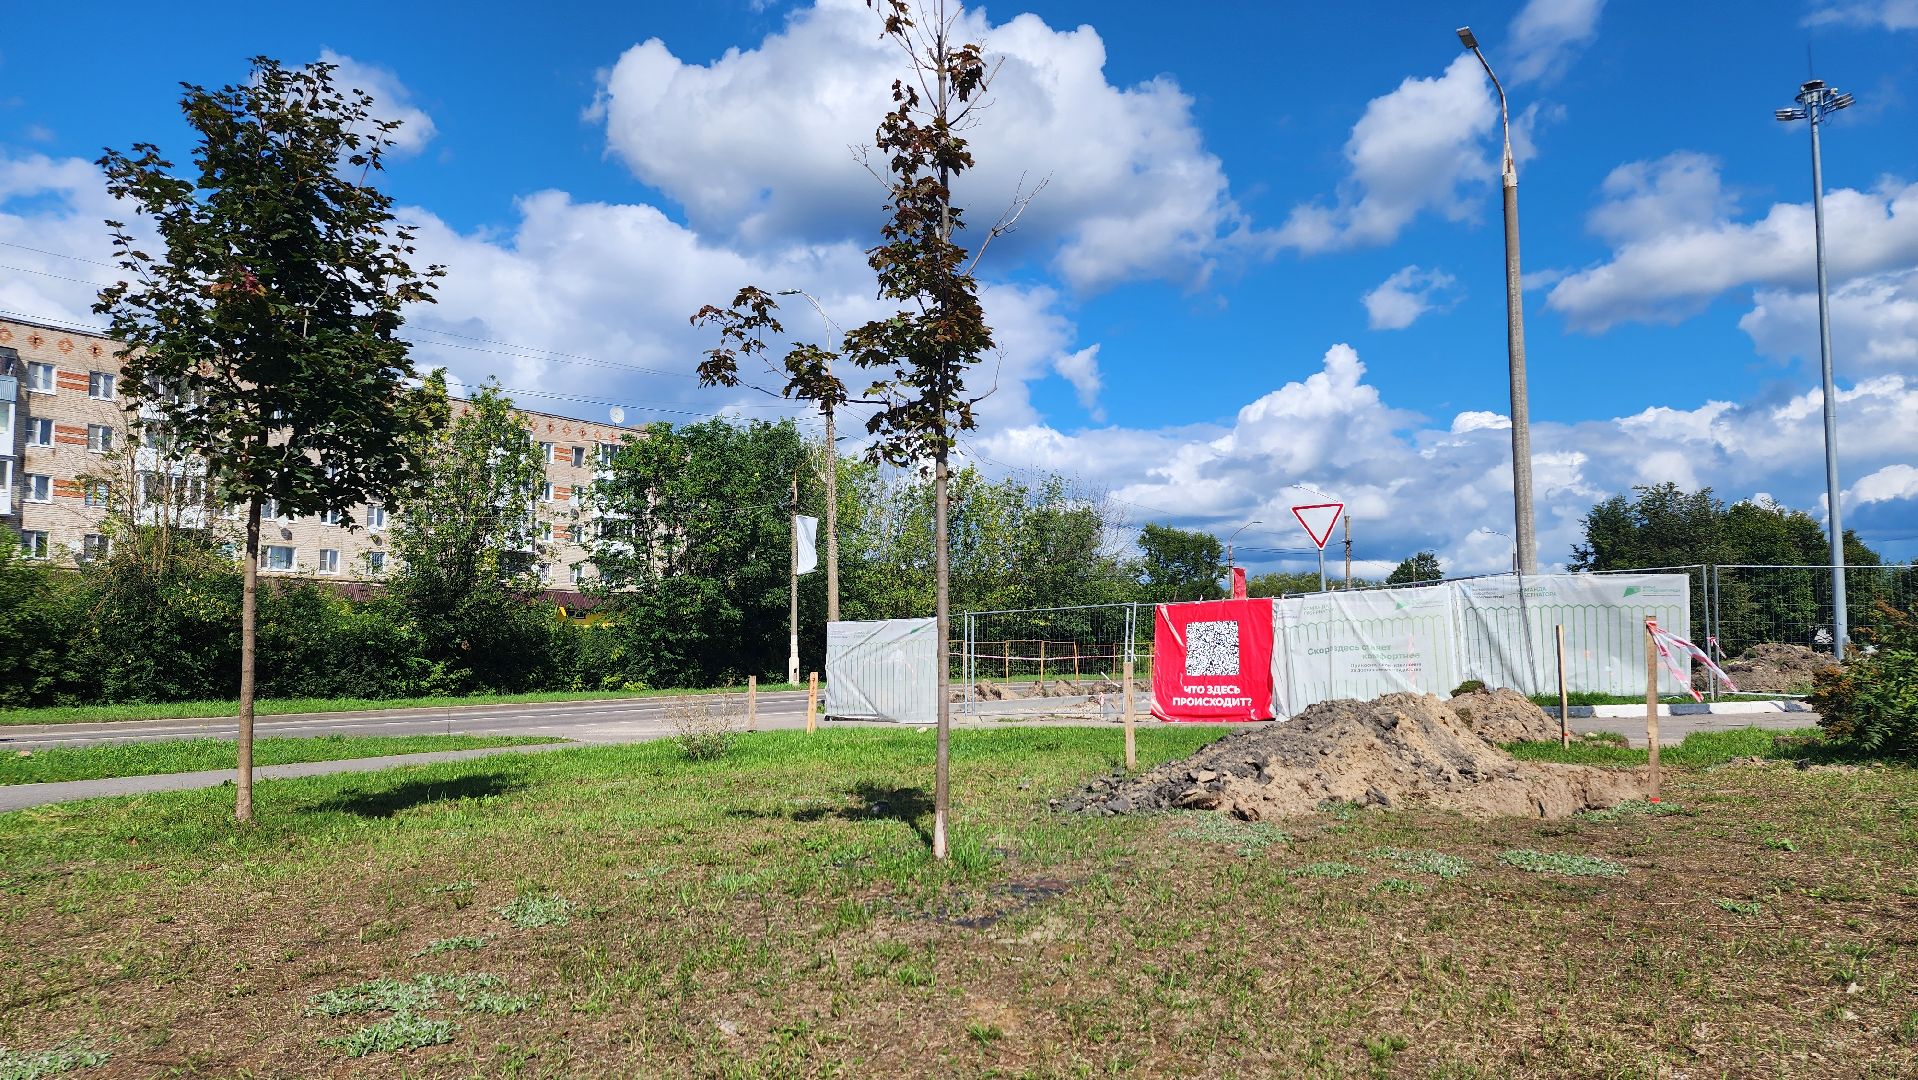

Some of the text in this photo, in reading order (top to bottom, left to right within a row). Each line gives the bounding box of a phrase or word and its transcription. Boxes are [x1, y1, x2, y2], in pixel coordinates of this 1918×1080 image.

[1183, 685, 1241, 696] ЧТО ЗДЕСЬ
[1172, 697, 1252, 708] ПРОИСХОДИТ?
